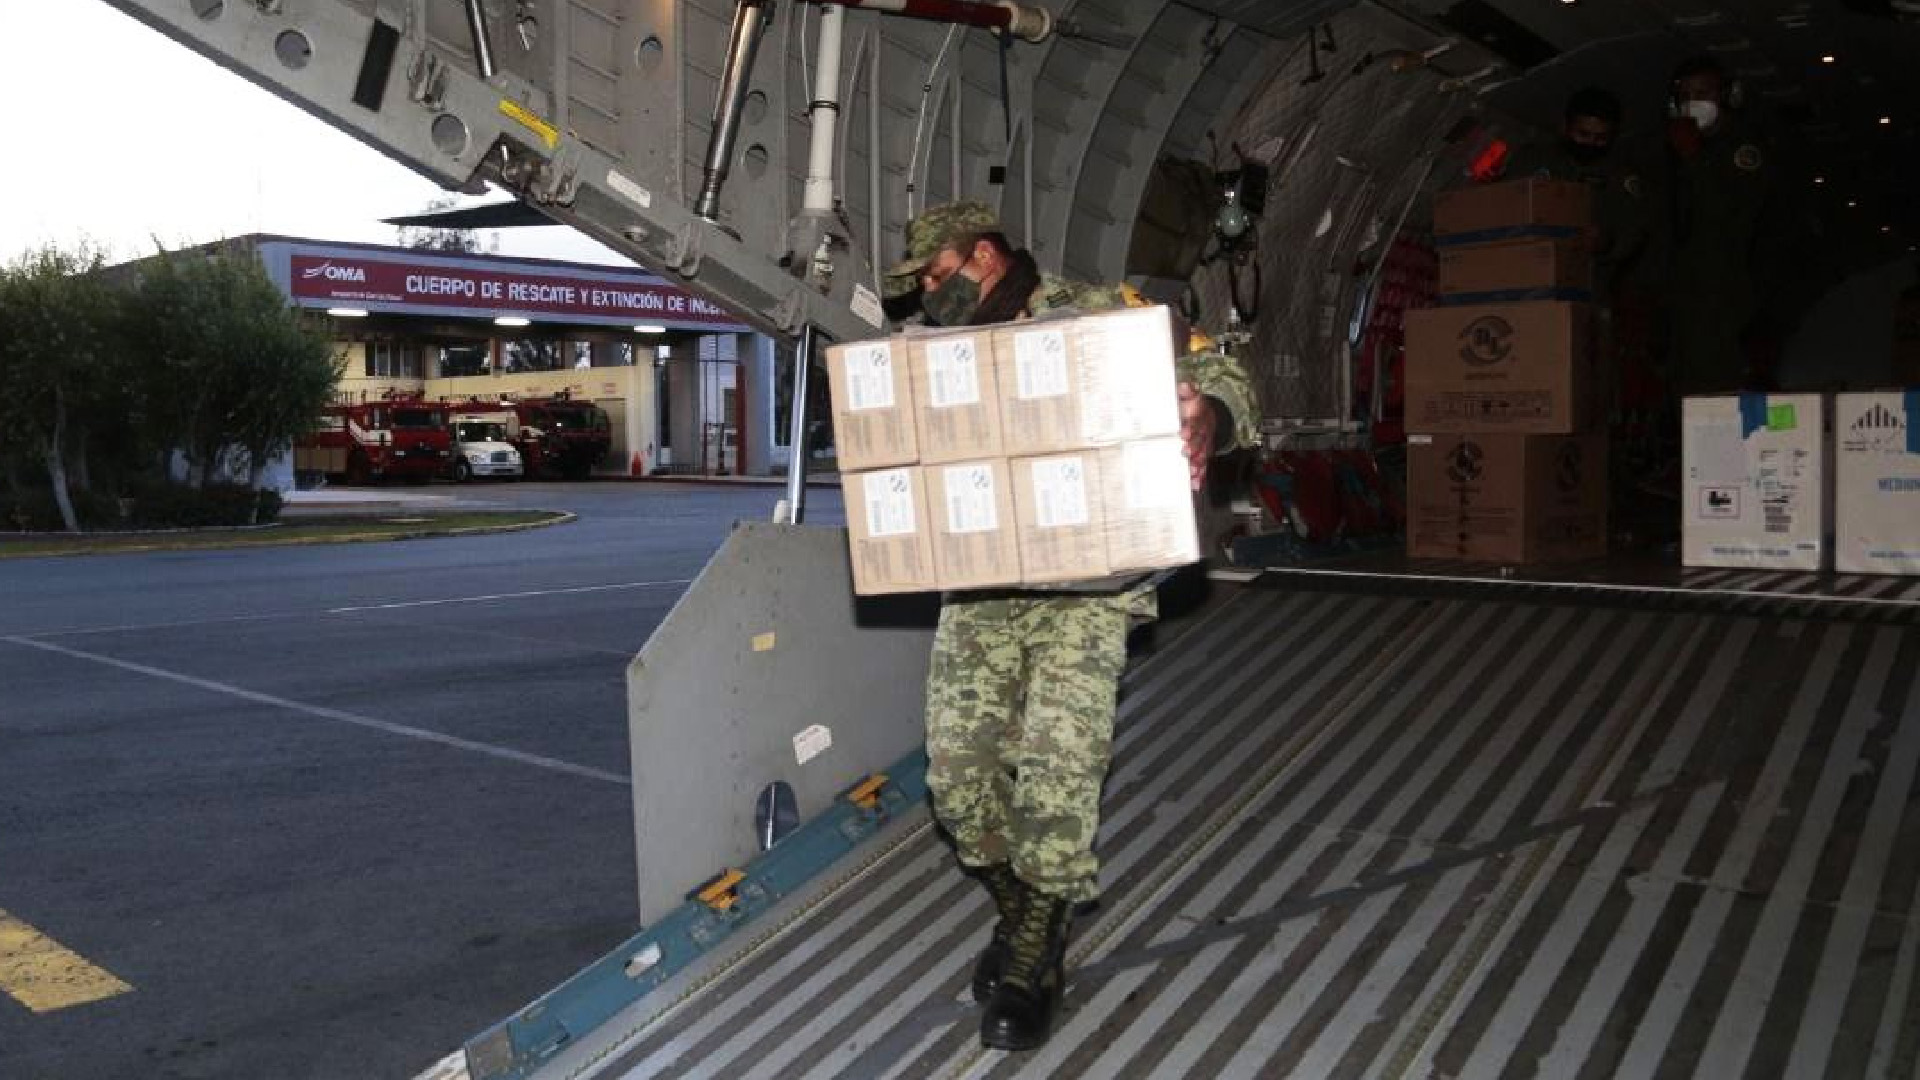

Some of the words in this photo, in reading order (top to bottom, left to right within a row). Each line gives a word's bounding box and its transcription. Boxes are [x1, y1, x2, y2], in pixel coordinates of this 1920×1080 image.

[325, 266, 365, 281] OMA
[405, 275, 475, 296] CUERPO
[481, 280, 503, 299] DE
[508, 282, 575, 303] RESCATE
[581, 289, 588, 305] Y
[592, 290, 663, 309] EXTINCIÓN
[667, 296, 684, 311] DE
